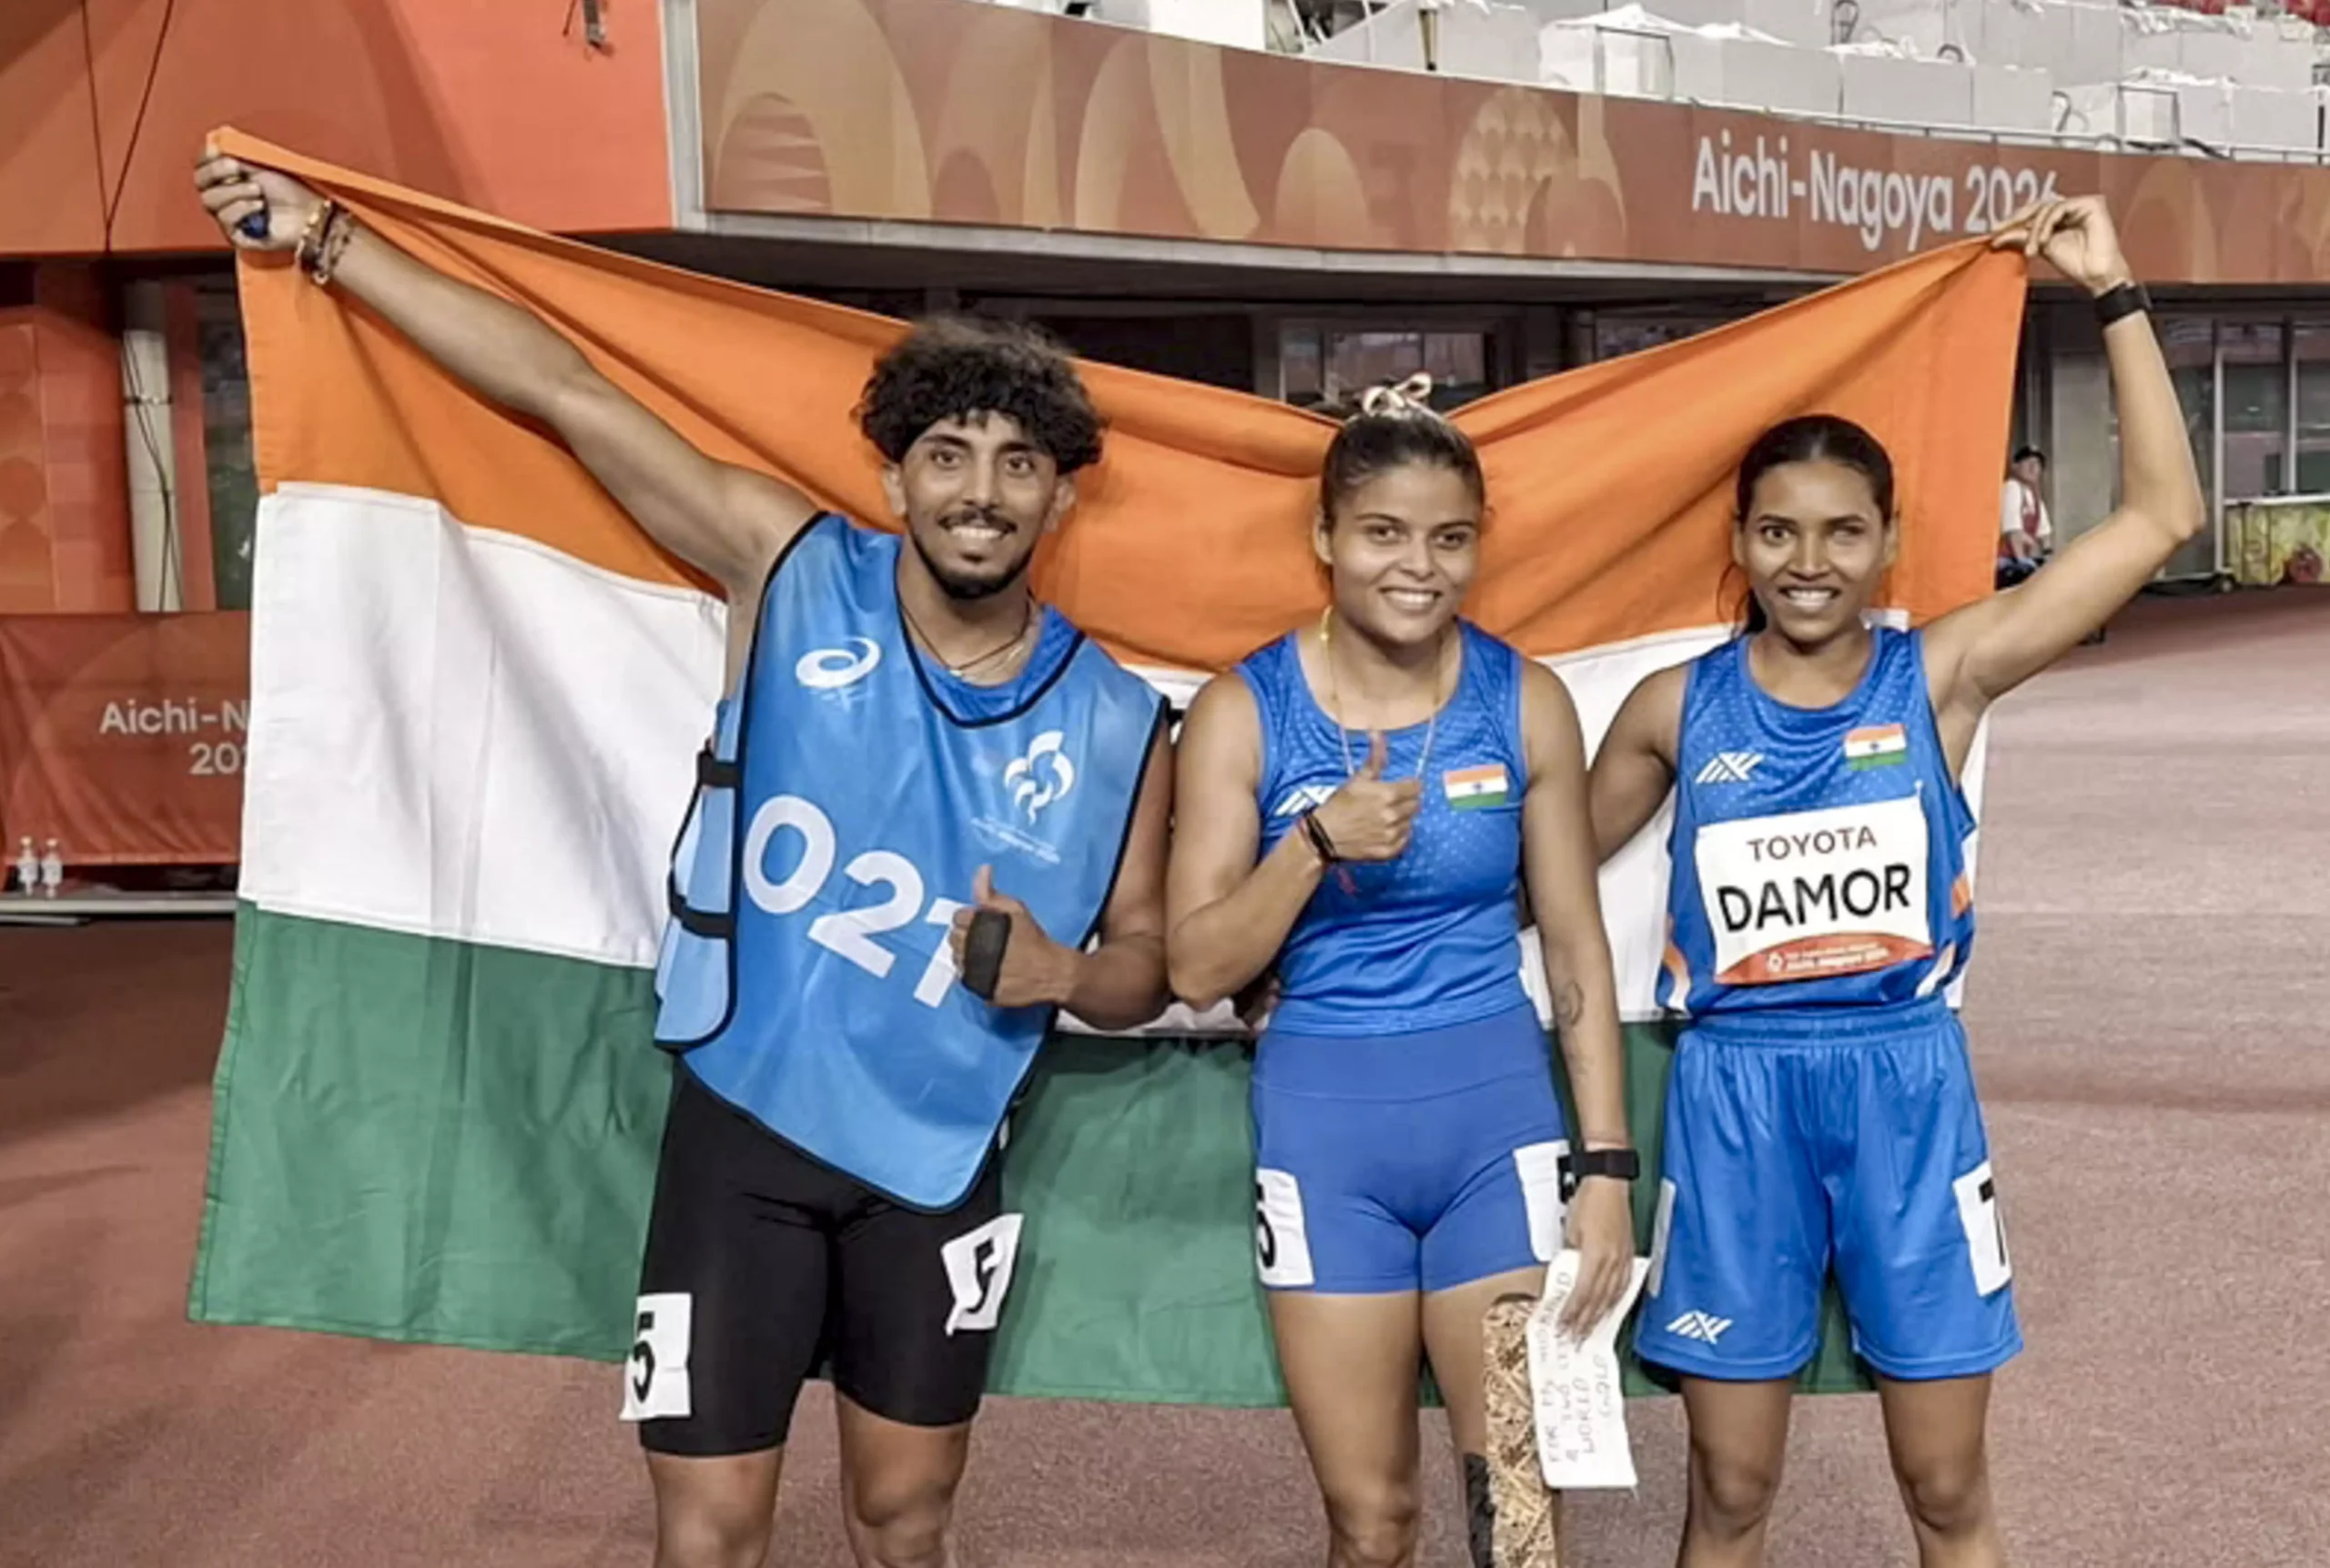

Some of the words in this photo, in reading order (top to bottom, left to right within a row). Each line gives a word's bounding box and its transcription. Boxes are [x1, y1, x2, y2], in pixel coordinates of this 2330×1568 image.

[1692, 129, 1952, 251] Aichi-Nagoya
[189, 742, 247, 774] 20
[1748, 825, 1877, 861] TOYOTA
[1717, 863, 1910, 932] DAMOR
